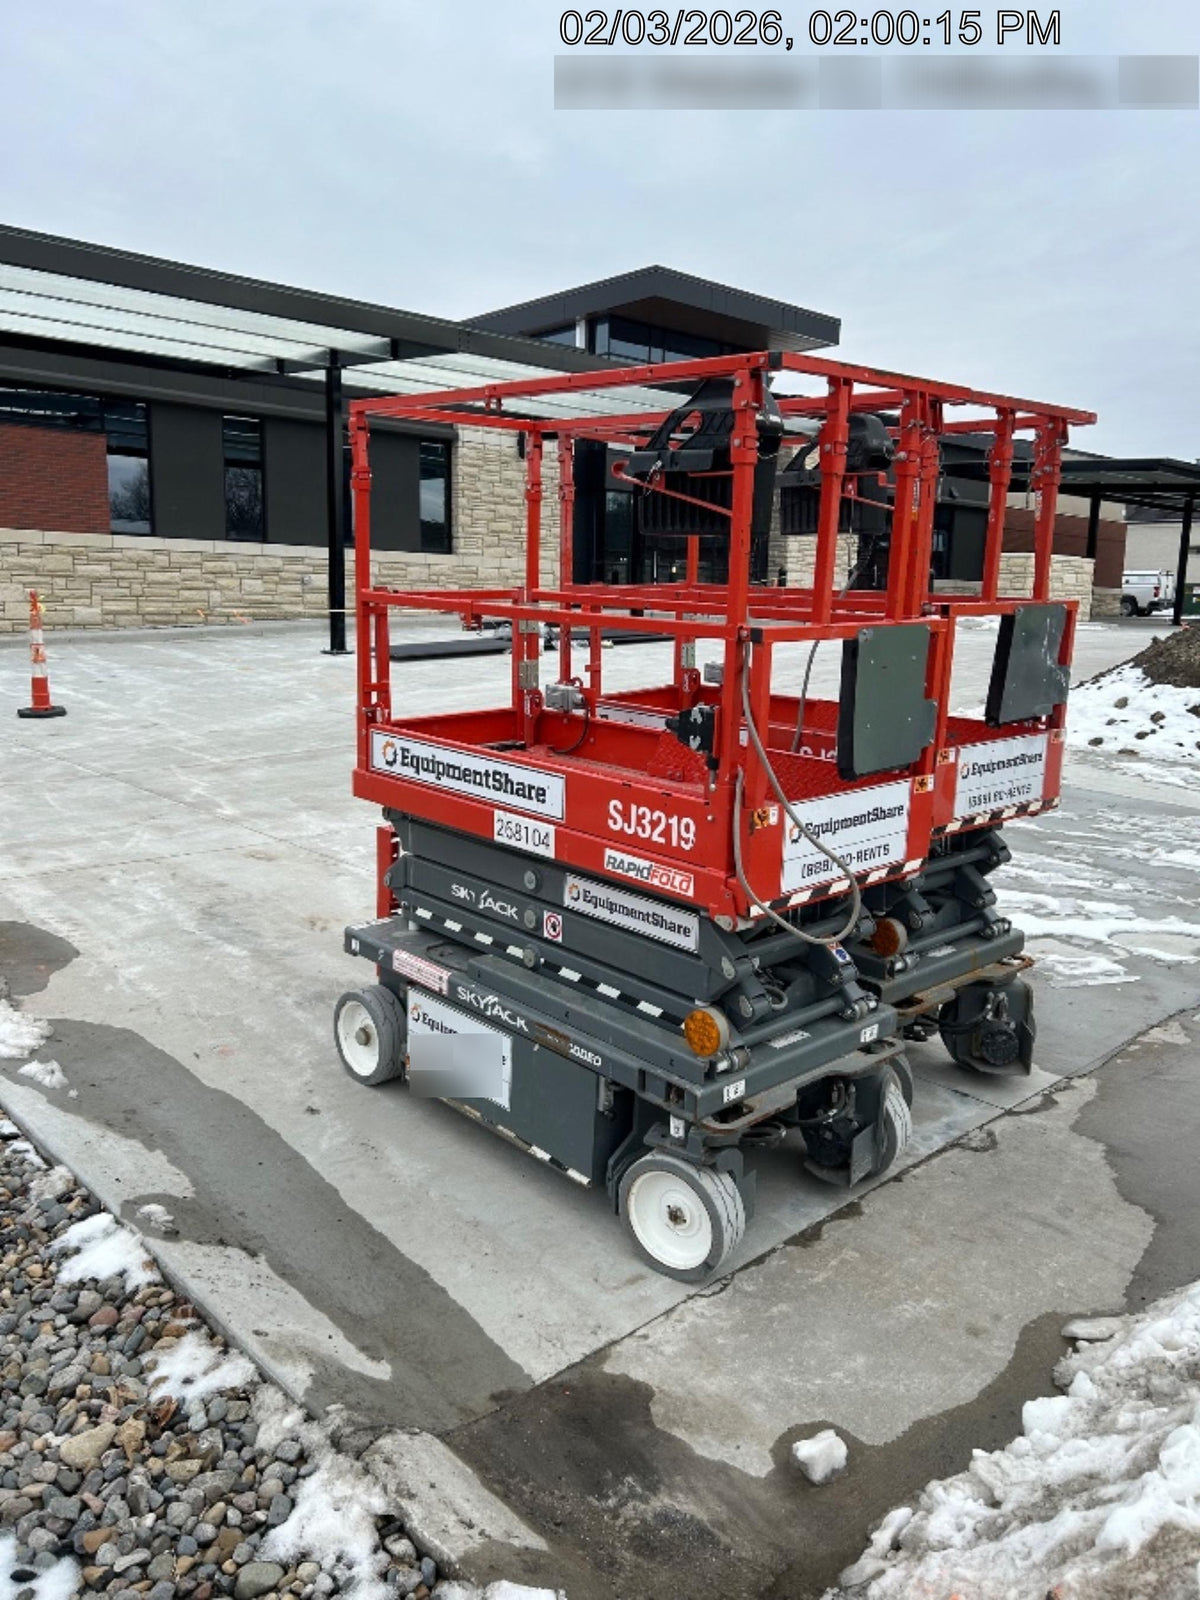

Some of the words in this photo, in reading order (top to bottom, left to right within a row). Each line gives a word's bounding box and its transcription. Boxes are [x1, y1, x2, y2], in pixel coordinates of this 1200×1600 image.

[401, 746, 547, 805] EquipmentShare
[496, 818, 551, 849] 268104
[607, 799, 696, 850] SJ3219
[804, 804, 905, 840] EquipmentShare
[582, 888, 692, 938] EquipmentShare
[456, 985, 530, 1033] SKYJACK
